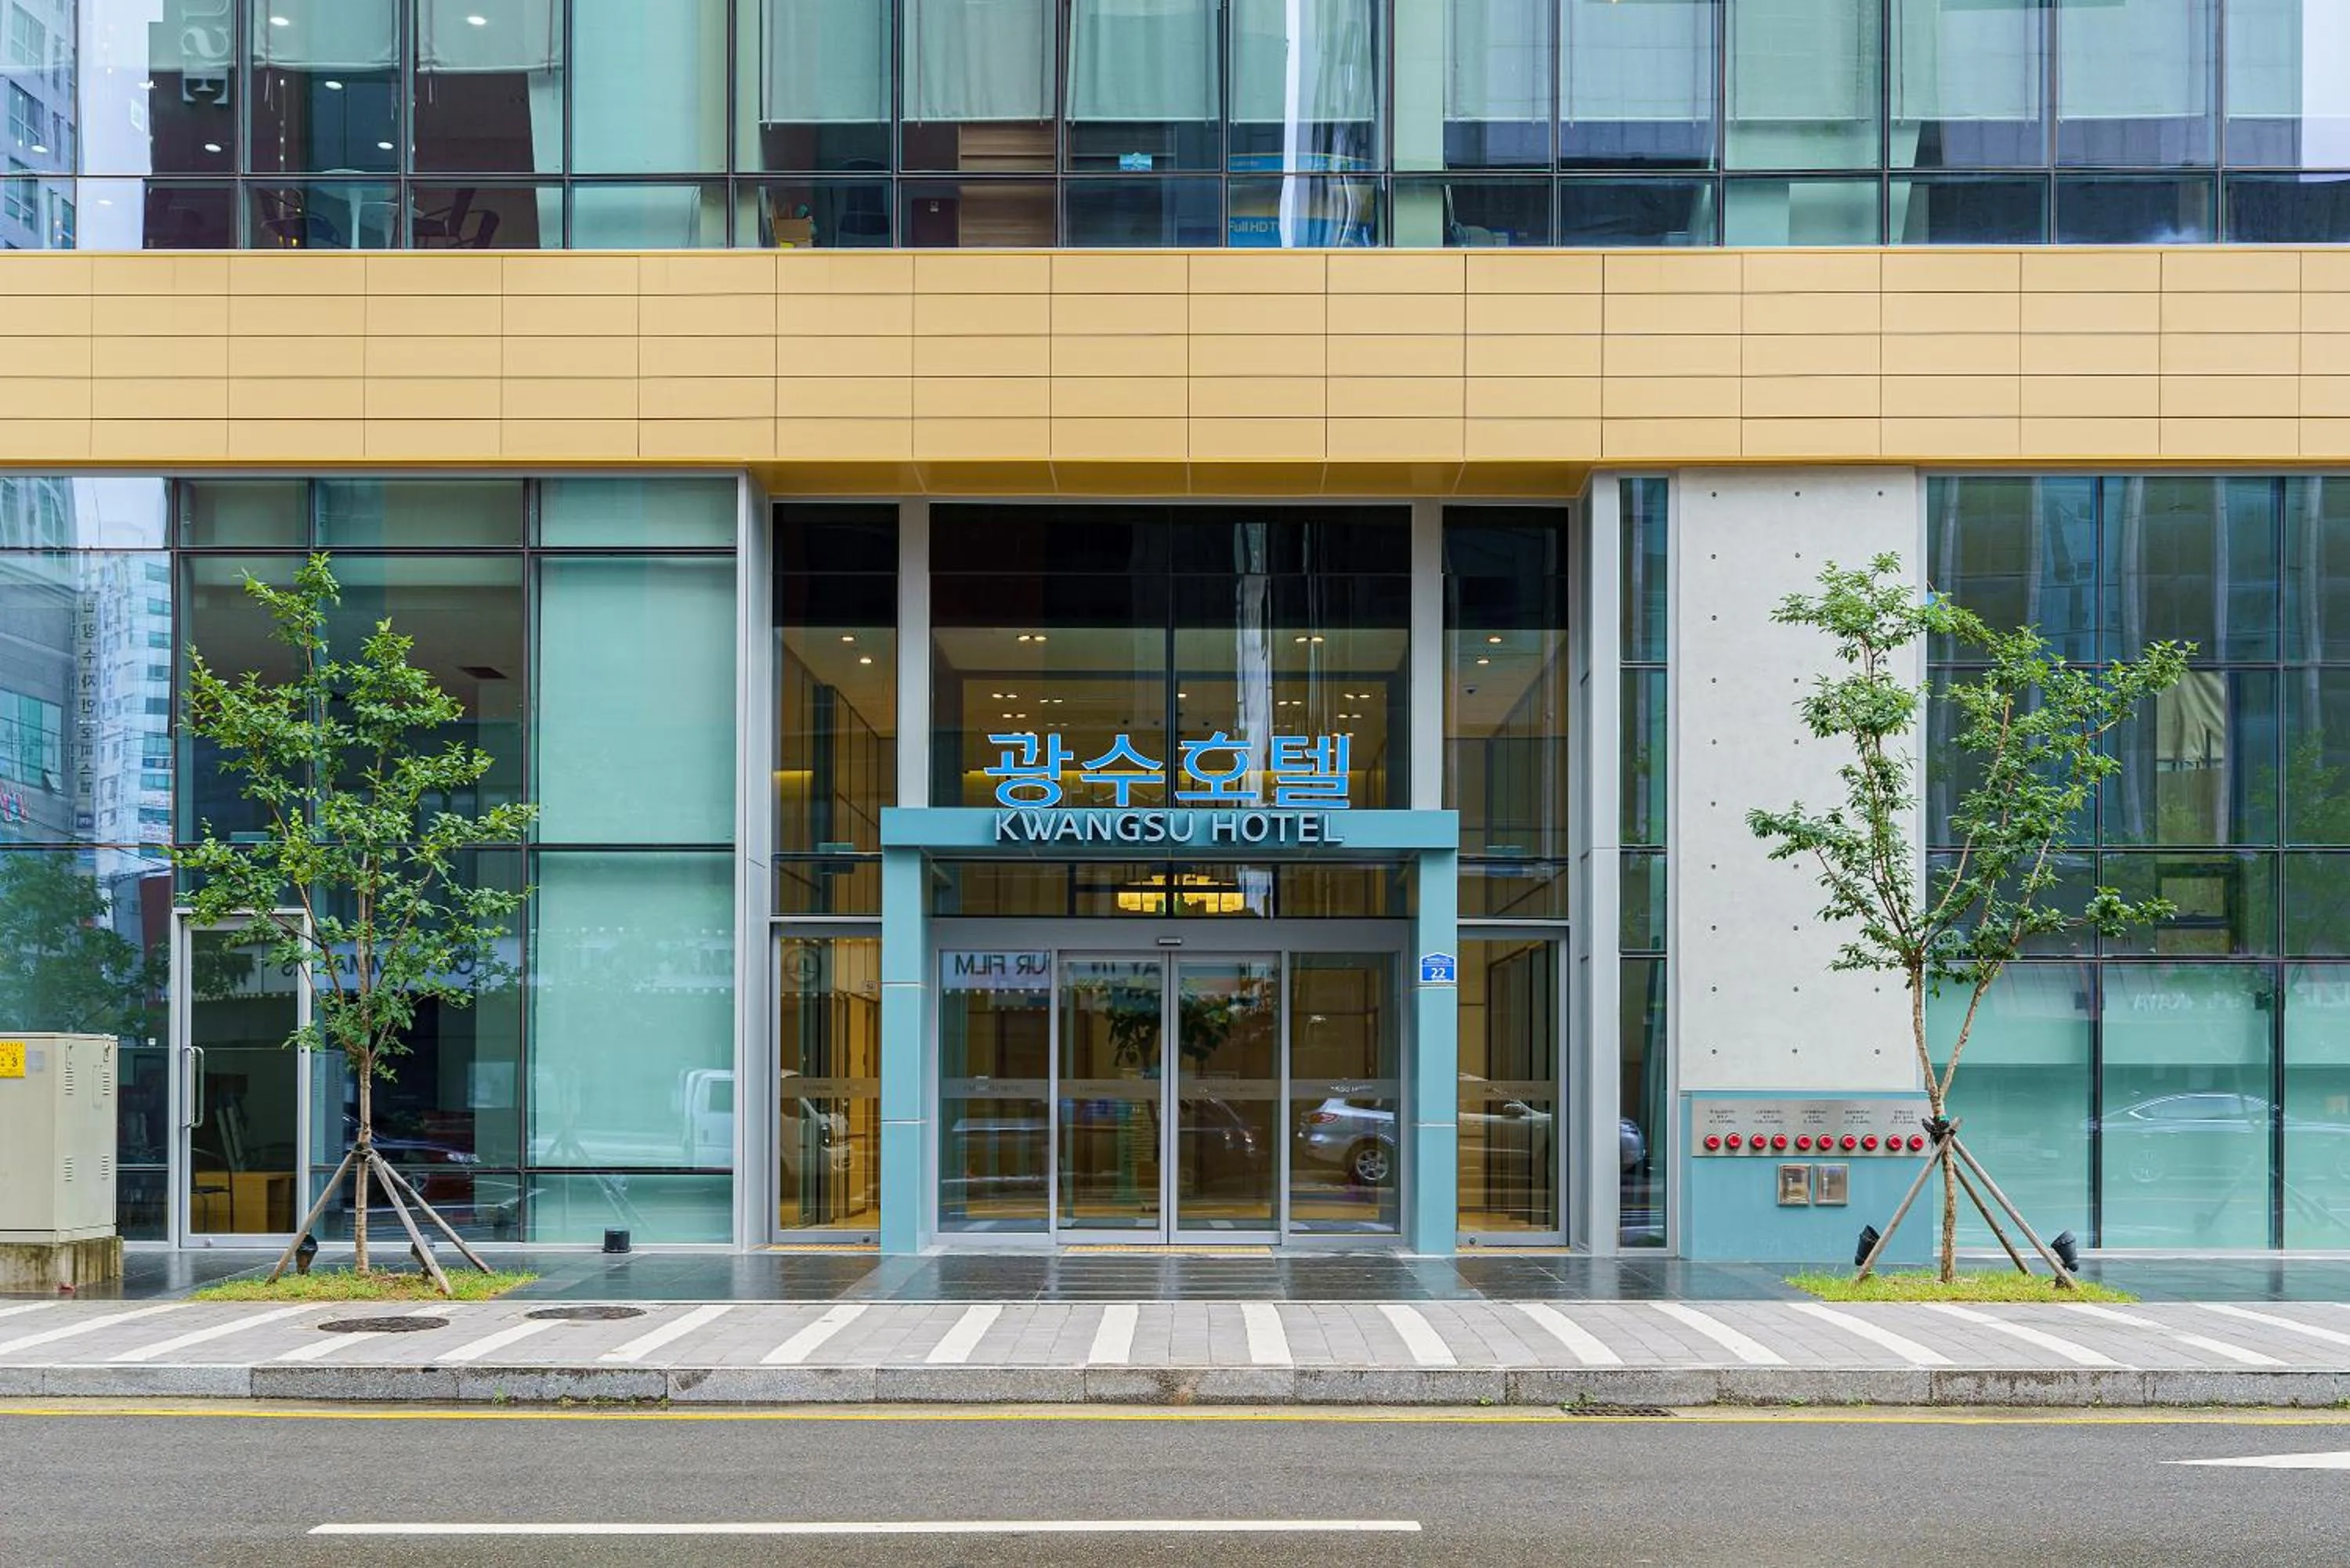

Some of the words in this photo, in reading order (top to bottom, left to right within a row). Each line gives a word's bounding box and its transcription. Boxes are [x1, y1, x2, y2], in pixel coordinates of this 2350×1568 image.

[984, 731, 1350, 808] 광수호텔
[995, 811, 1195, 843] KWANGSU
[1212, 812, 1345, 843] HOTEL
[1431, 967, 1446, 978] 22
